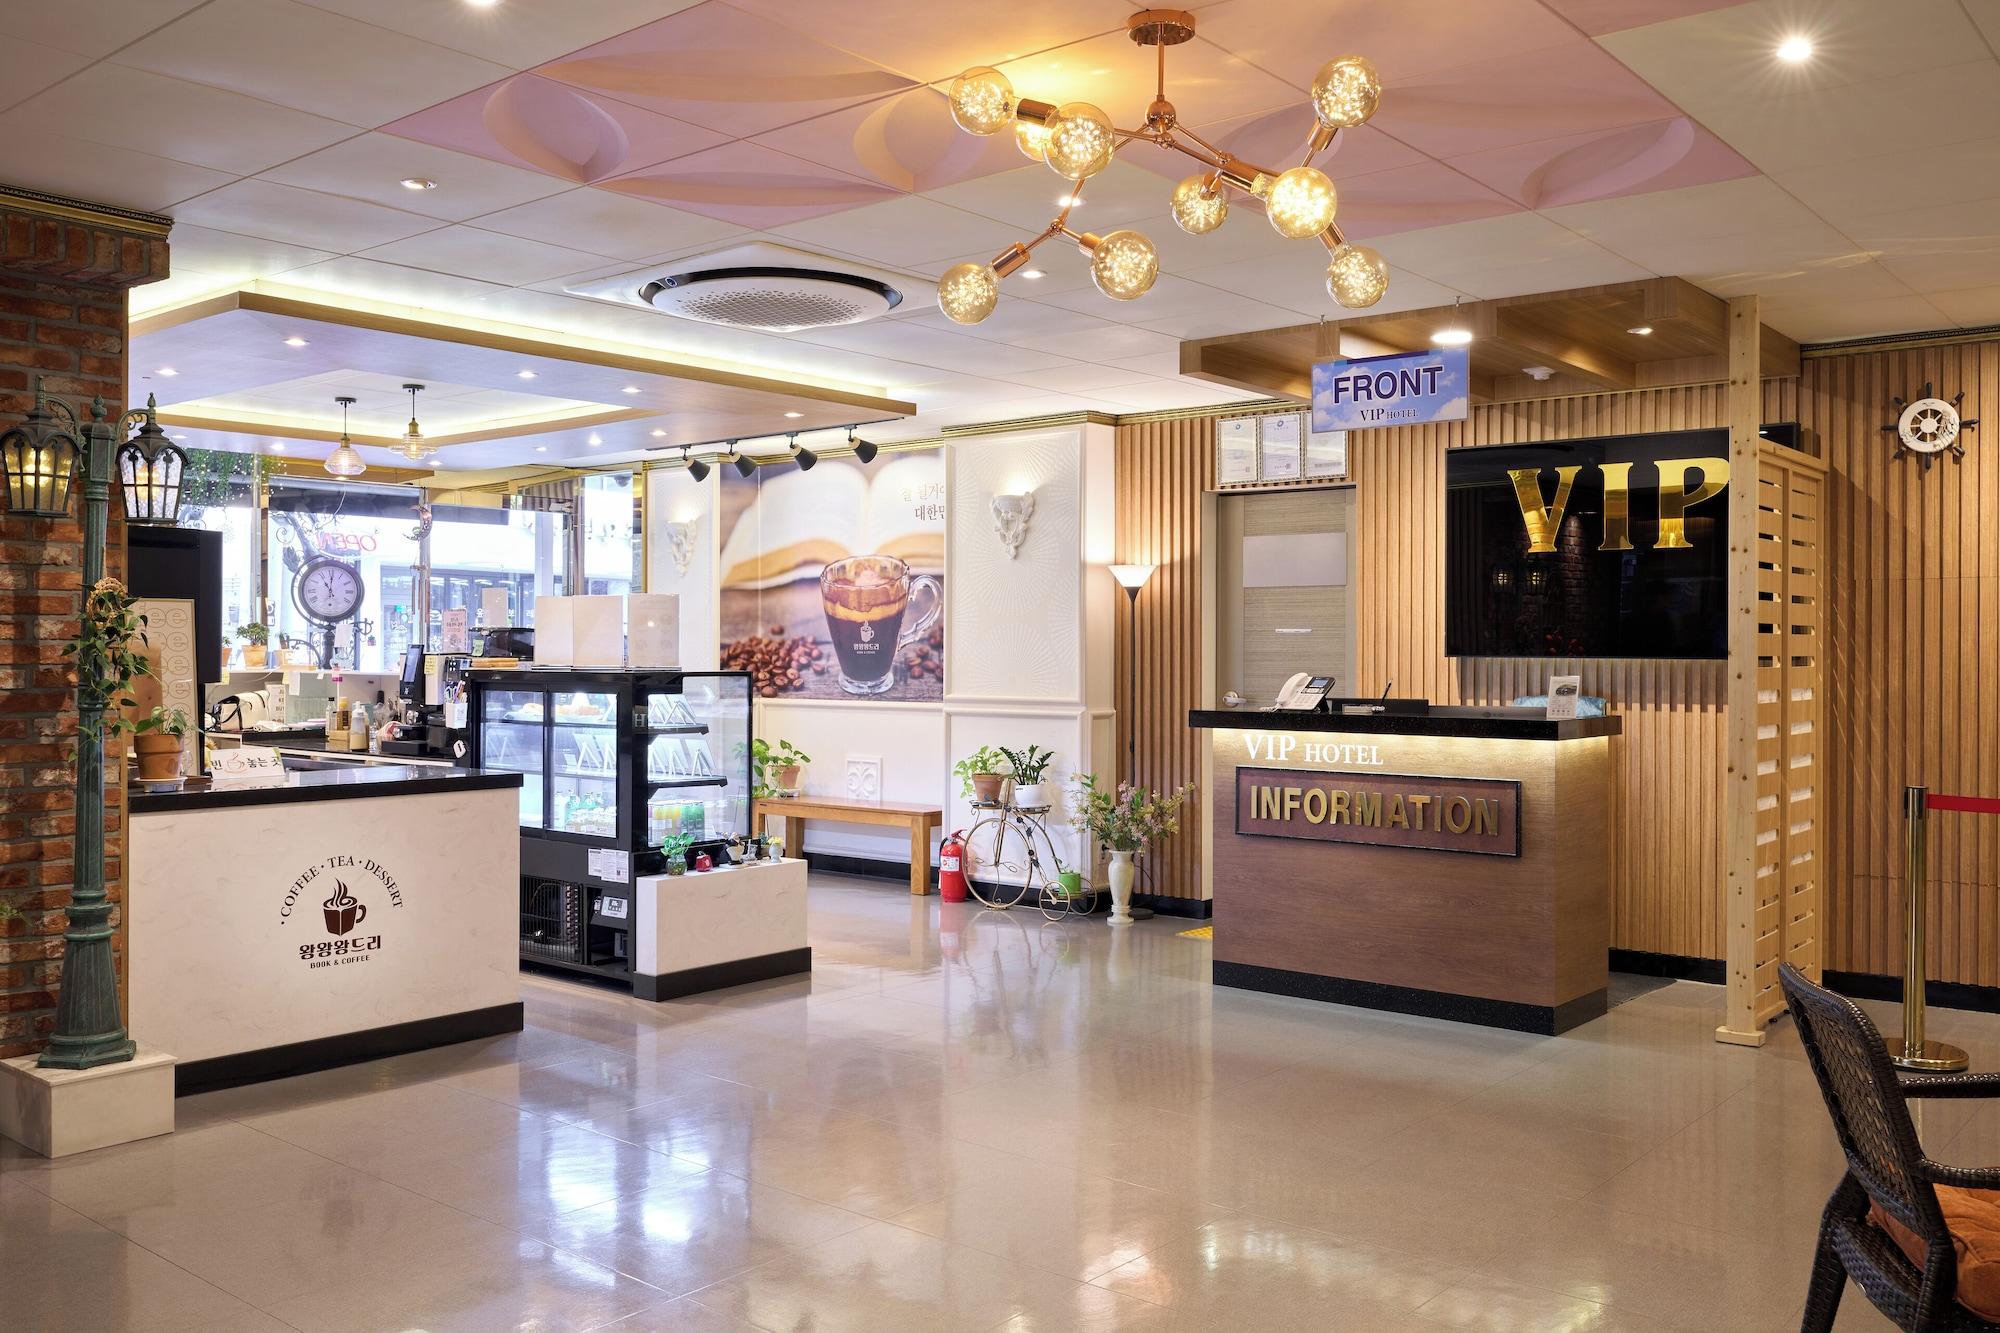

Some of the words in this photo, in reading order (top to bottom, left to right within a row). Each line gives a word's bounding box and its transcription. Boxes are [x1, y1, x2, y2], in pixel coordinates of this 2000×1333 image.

[1333, 366, 1443, 403] FRONT
[1361, 408, 1385, 421] VIP
[1387, 408, 1419, 419] HOTEL
[1507, 457, 1730, 553] VIP
[209, 759, 223, 771] 빈
[247, 757, 268, 768] 놓는
[1243, 734, 1296, 761] VIP
[1304, 743, 1384, 766] HOTEL
[1250, 784, 1499, 837] INFORMATION
[280, 865, 320, 918] COFFEE
[327, 855, 355, 870] TEA
[364, 859, 403, 910] DESSERT
[299, 935, 381, 960] 왕왕왕드리
[310, 960, 331, 969] BOOK
[341, 954, 371, 965] COFFEE
